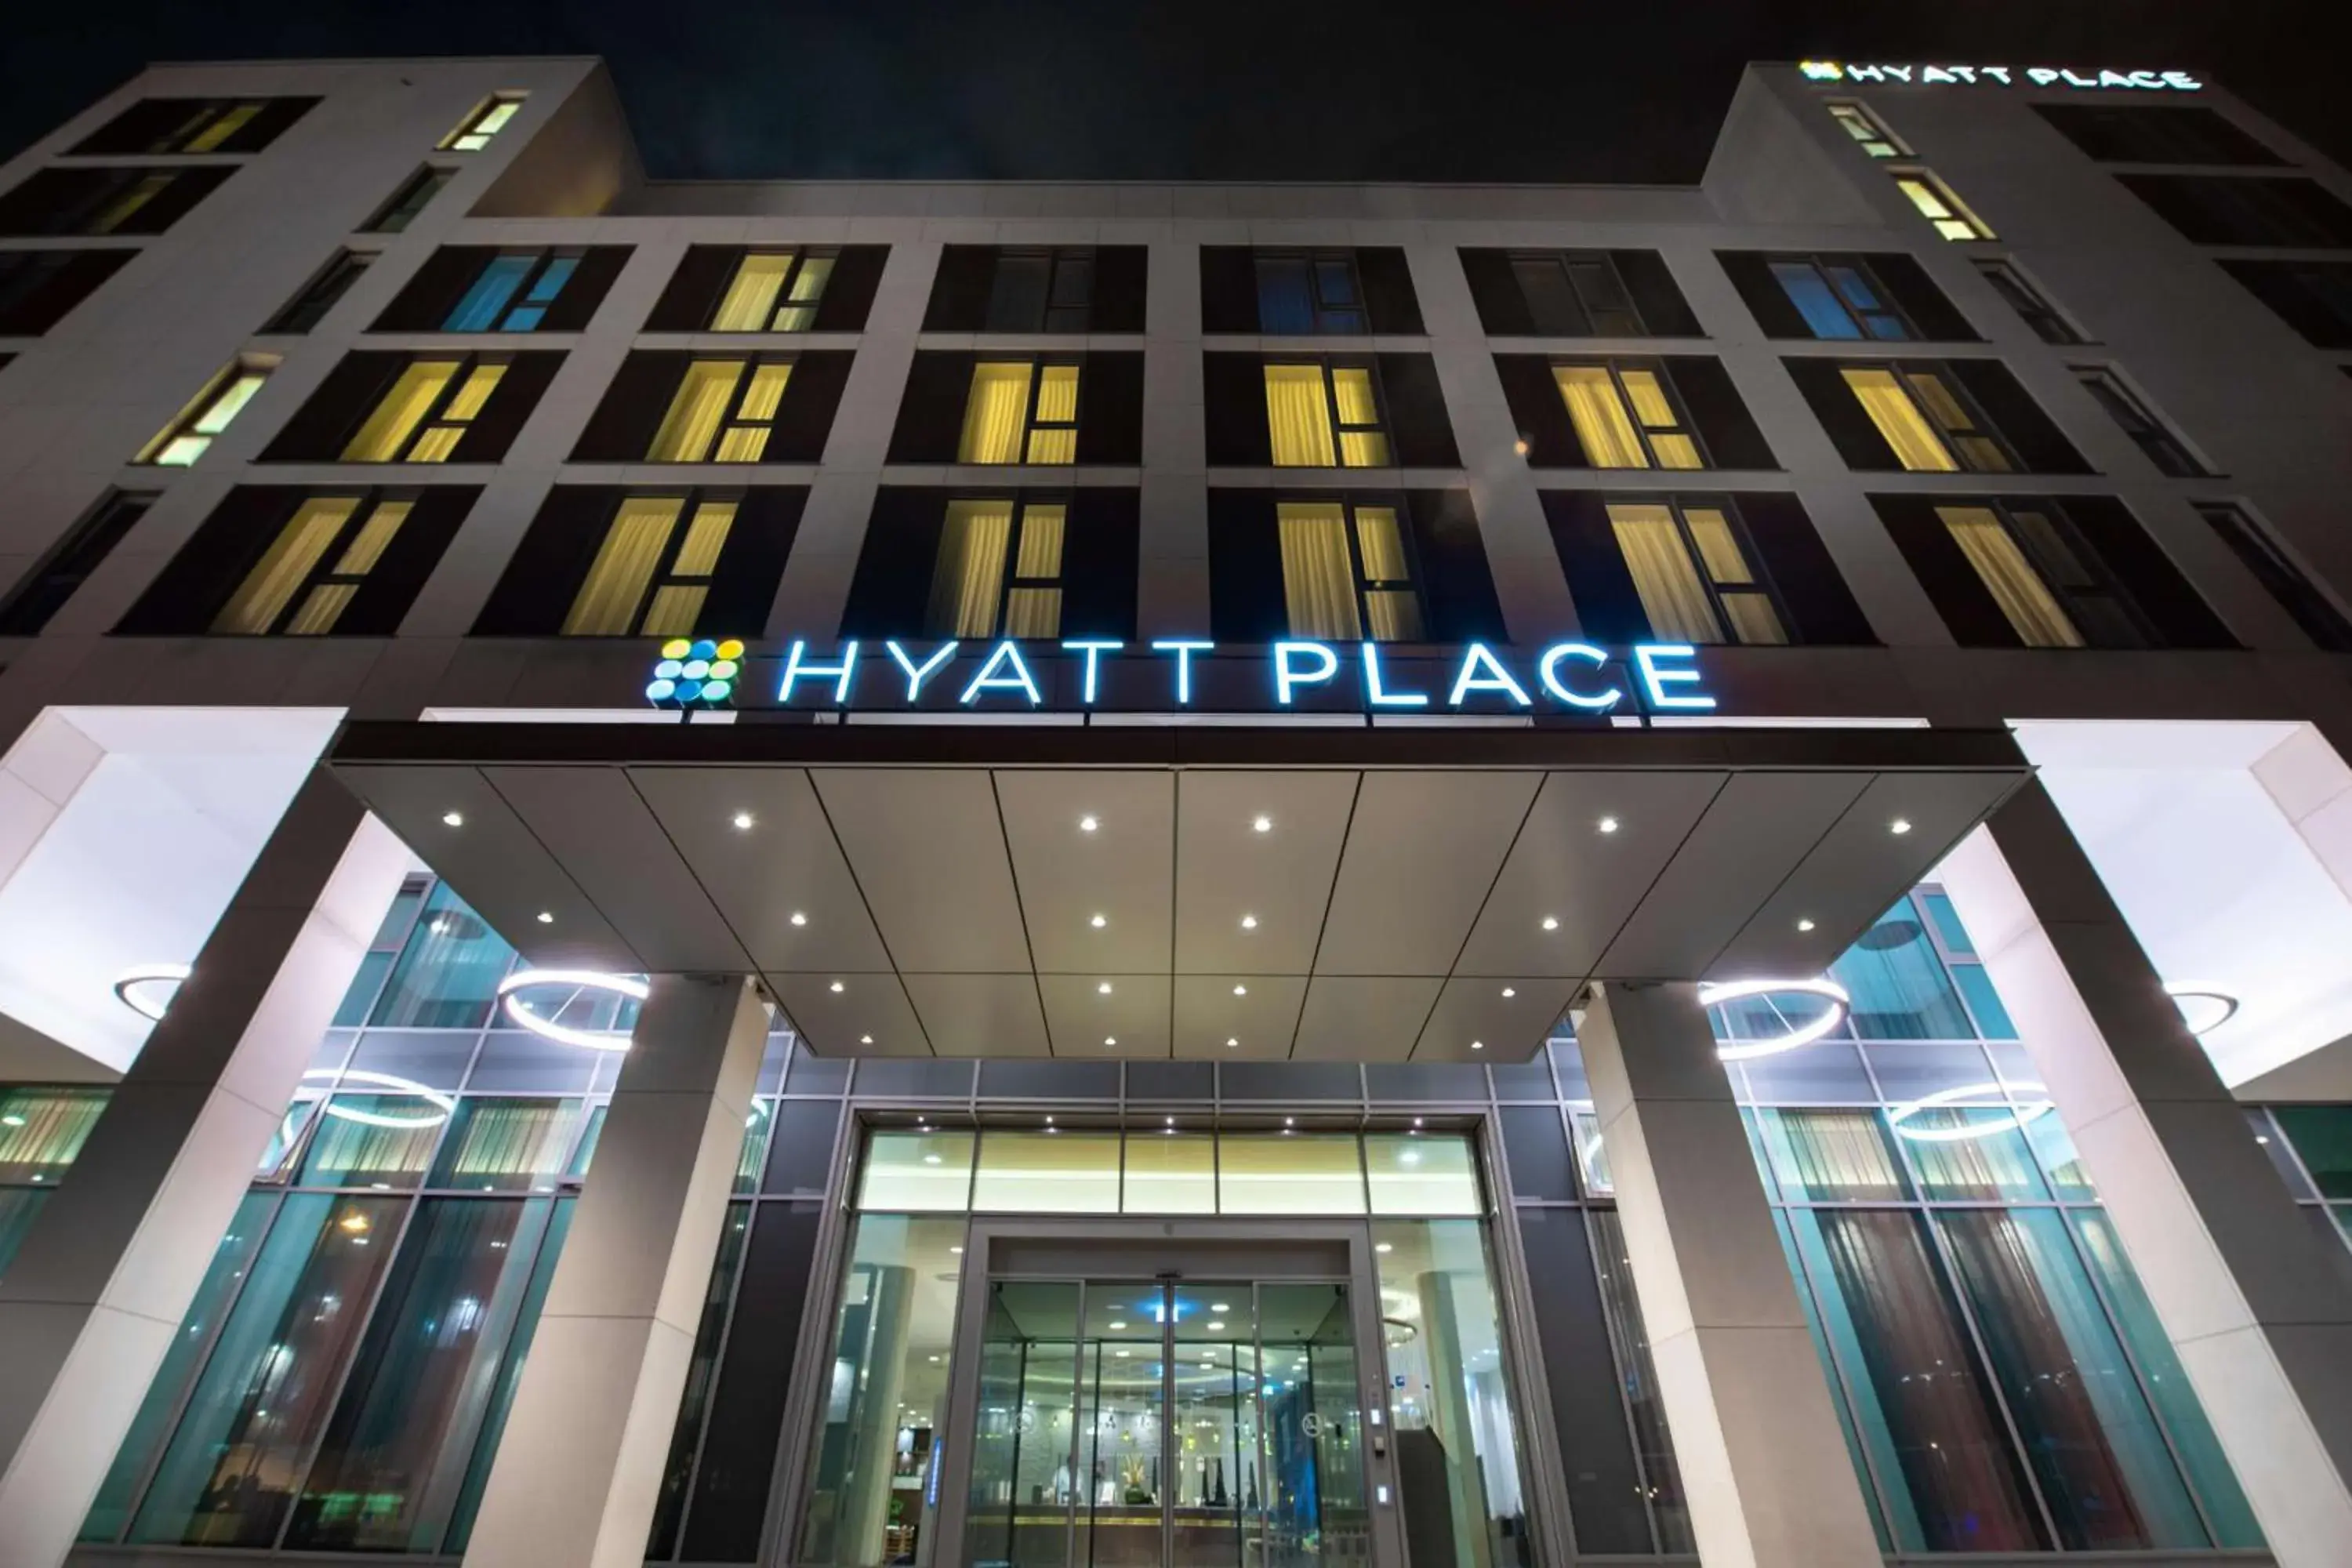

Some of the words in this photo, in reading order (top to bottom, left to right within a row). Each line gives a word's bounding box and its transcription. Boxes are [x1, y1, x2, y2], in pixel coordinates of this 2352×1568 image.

[1847, 65, 2010, 84] HYATT
[2027, 67, 2202, 89] PLACE
[778, 640, 1215, 703] HYATT
[1273, 641, 1717, 708] PLACE
